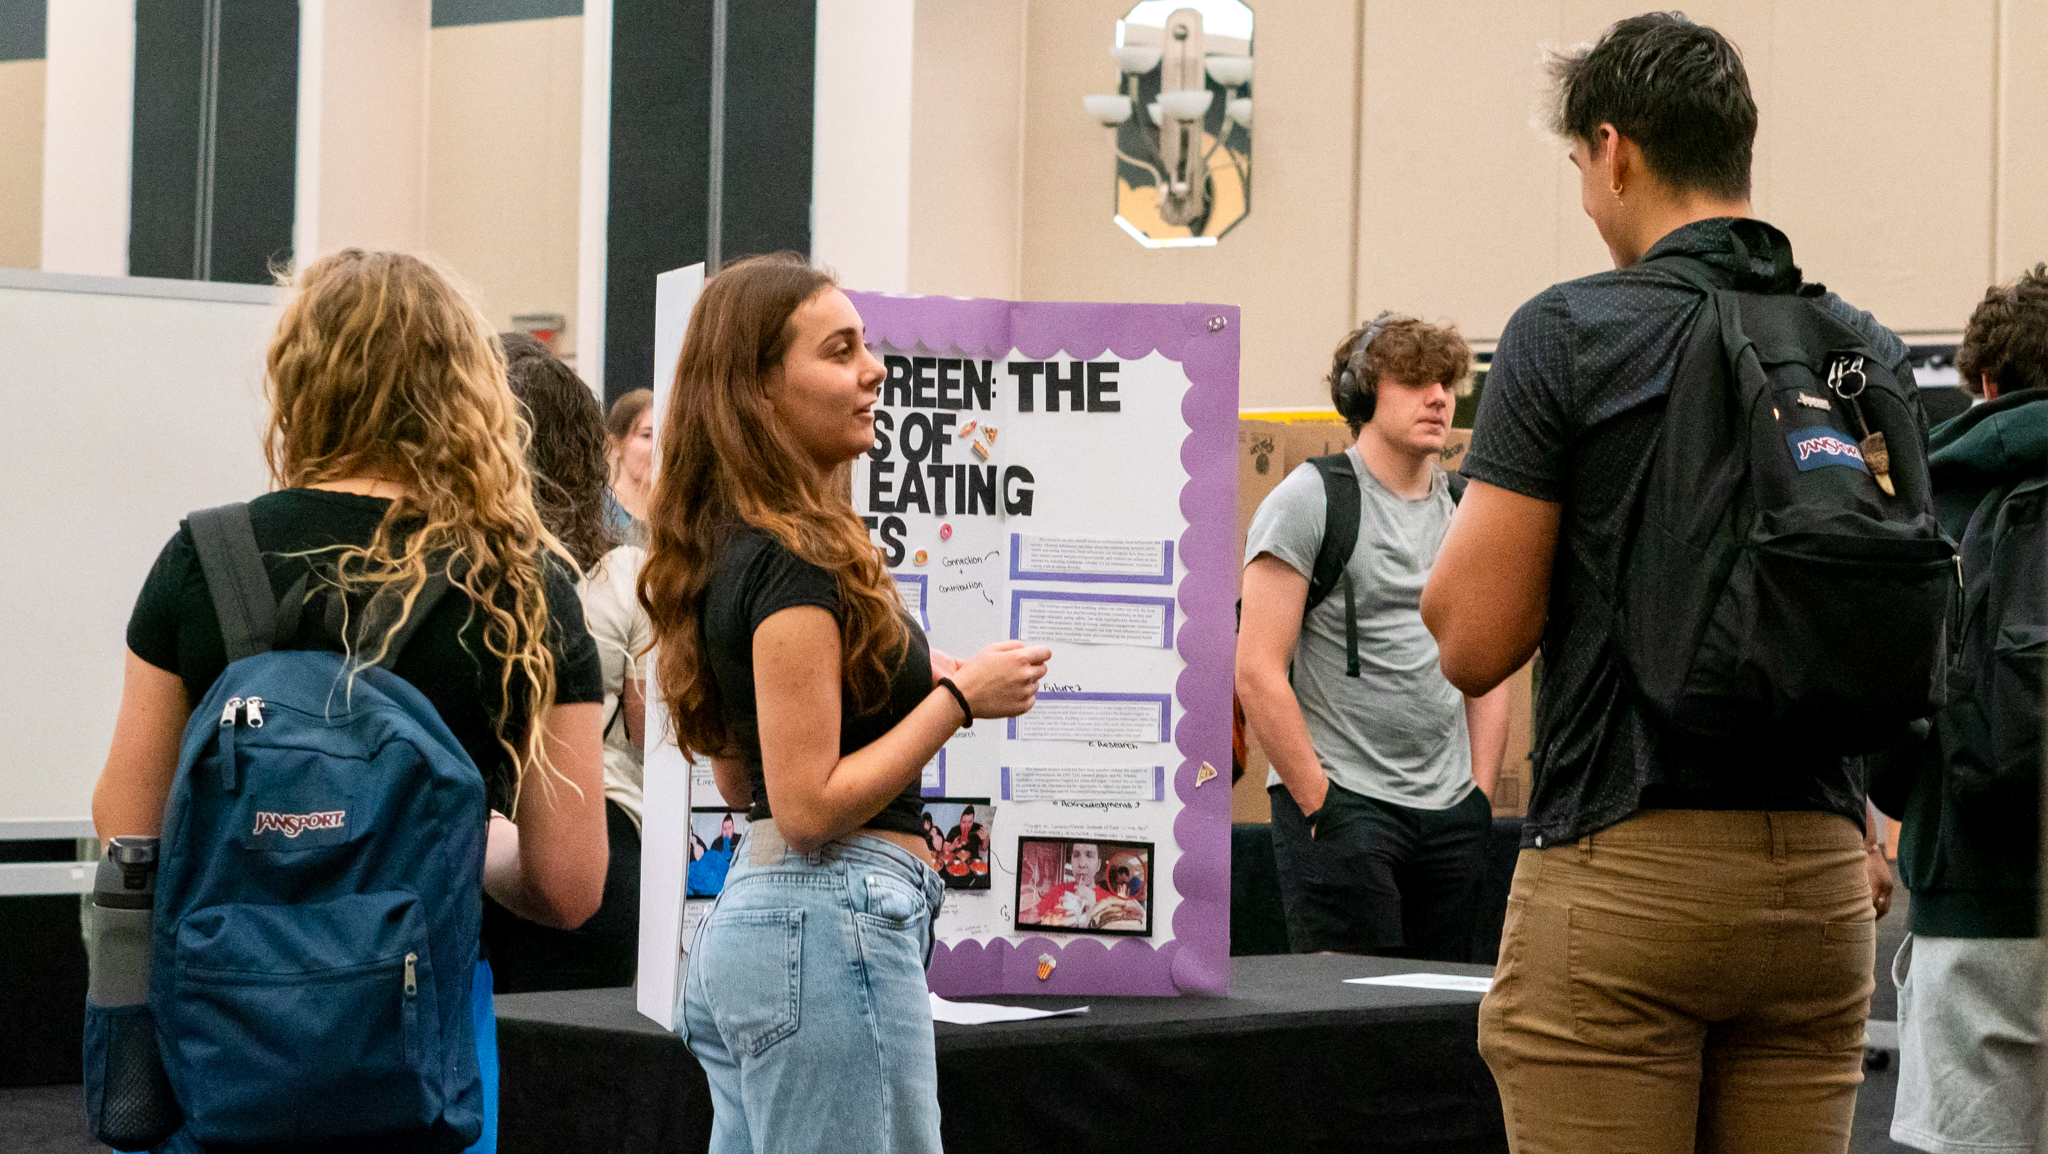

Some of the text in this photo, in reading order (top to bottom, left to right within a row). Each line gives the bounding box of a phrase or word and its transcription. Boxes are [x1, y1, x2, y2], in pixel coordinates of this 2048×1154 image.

[877, 355, 1121, 412] REEN: THE
[867, 409, 957, 464] S OF
[869, 461, 1035, 516] EATING
[252, 810, 346, 839] JANSPORT
